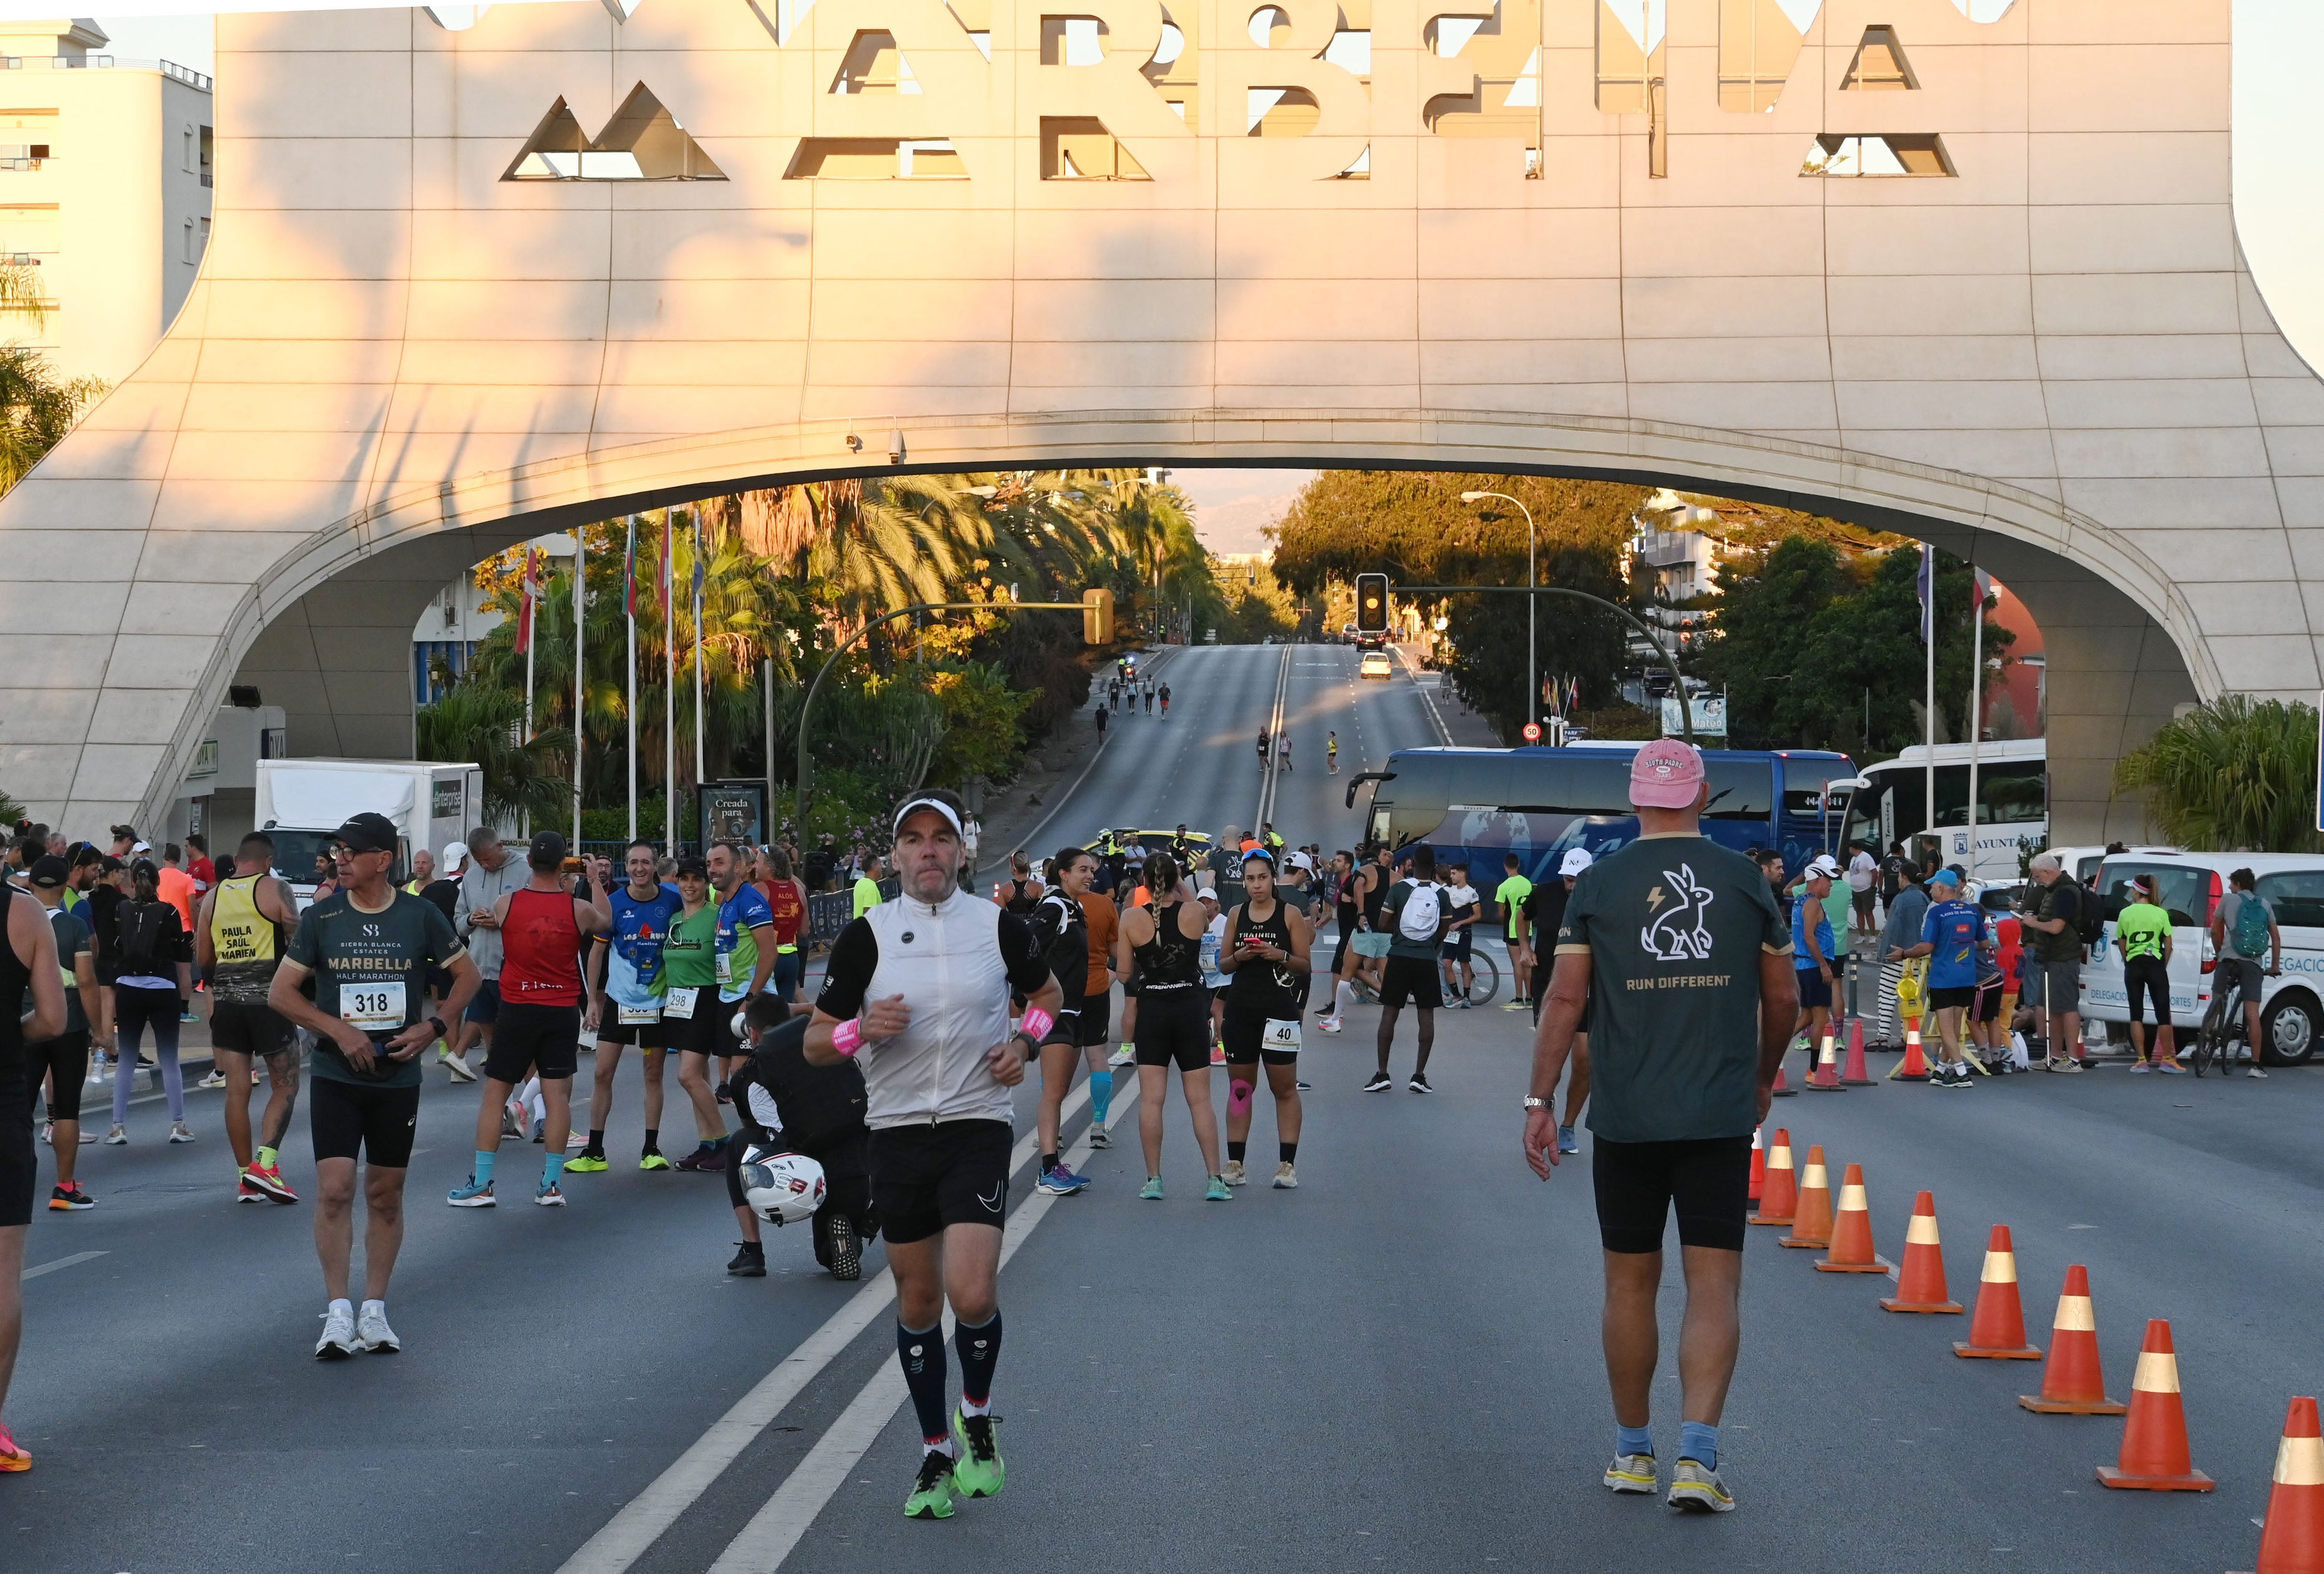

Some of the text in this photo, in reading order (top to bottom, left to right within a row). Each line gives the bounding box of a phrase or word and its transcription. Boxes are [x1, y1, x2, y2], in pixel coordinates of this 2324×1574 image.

[1692, 719, 1722, 727] Mateo
[1645, 759, 1683, 769] SOUTH PADRE
[433, 787, 461, 813] enterprise
[715, 799, 748, 807] Creada
[722, 810, 742, 819] para
[221, 926, 252, 938] PAULA
[226, 936, 251, 949] SAÚL
[221, 948, 256, 959] MARIEN
[328, 958, 412, 971] MARBELLA
[1626, 975, 1731, 990] RUN DIFFERENT
[356, 993, 388, 1013] 318
[671, 994, 686, 1006] 298
[1277, 1028, 1290, 1040] 40
